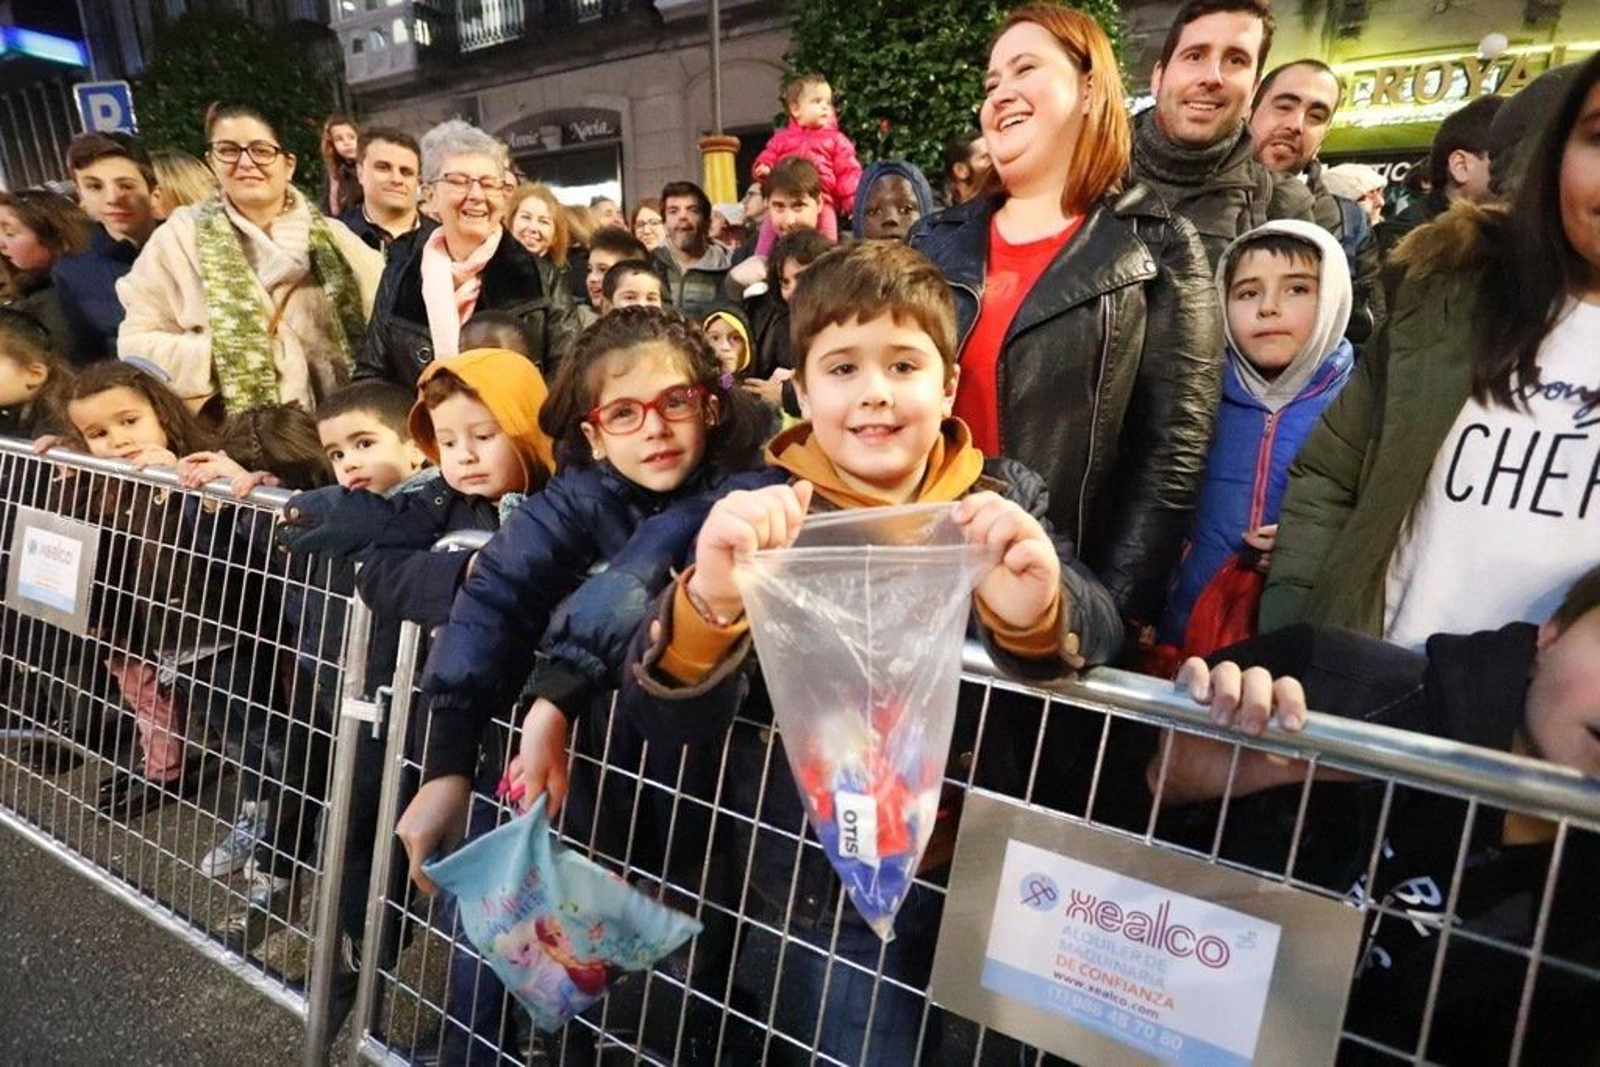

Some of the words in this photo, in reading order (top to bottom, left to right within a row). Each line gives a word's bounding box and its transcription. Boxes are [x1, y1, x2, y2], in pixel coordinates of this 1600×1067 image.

[88, 93, 122, 132] P
[1371, 161, 1412, 182] TIC
[843, 809, 859, 853] OTIS
[1061, 924, 1142, 961] ALQUILER
[1144, 950, 1169, 975] DE
[1065, 888, 1231, 969] xealco
[1055, 953, 1077, 970] DE
[1079, 962, 1176, 1011] CONFIANZA
[1059, 939, 1166, 990] MAQUINARIA
[1053, 969, 1161, 1021] www.xealco.com
[1134, 1019, 1156, 1040] 70
